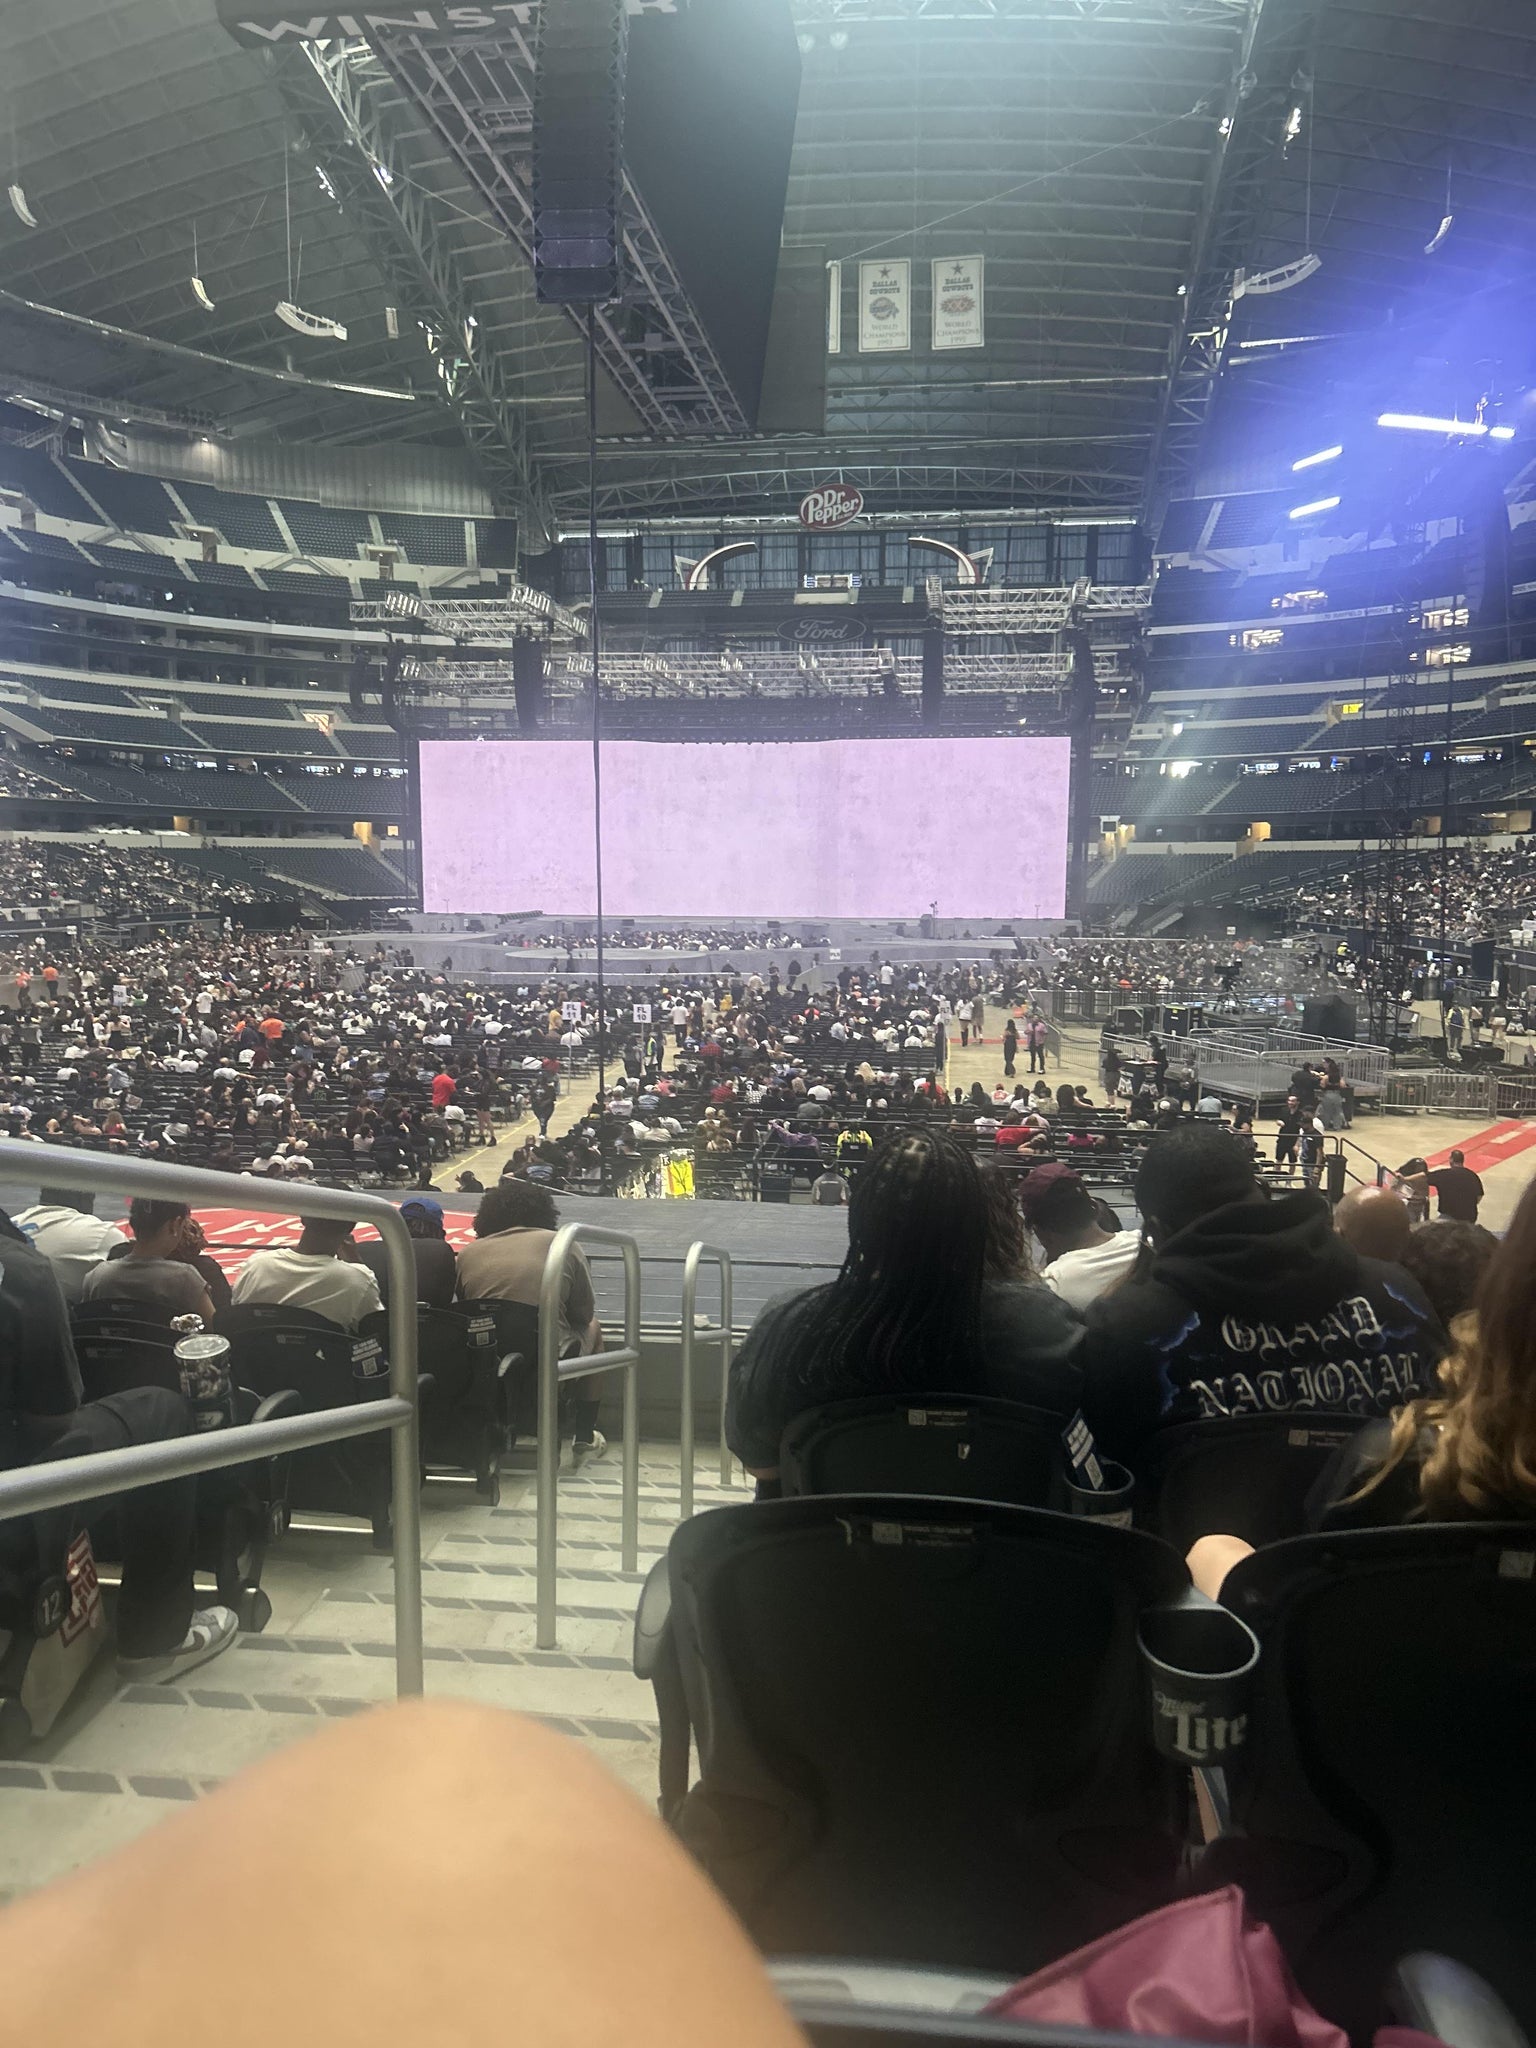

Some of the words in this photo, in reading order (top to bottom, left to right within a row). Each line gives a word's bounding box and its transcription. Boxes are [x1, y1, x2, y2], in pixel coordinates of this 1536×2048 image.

[802, 493, 859, 525] Pepper
[824, 489, 846, 508] Dr
[794, 619, 849, 639] Ford
[1190, 1352, 1420, 1418] NATIONAL
[43, 1590, 61, 1625] 12
